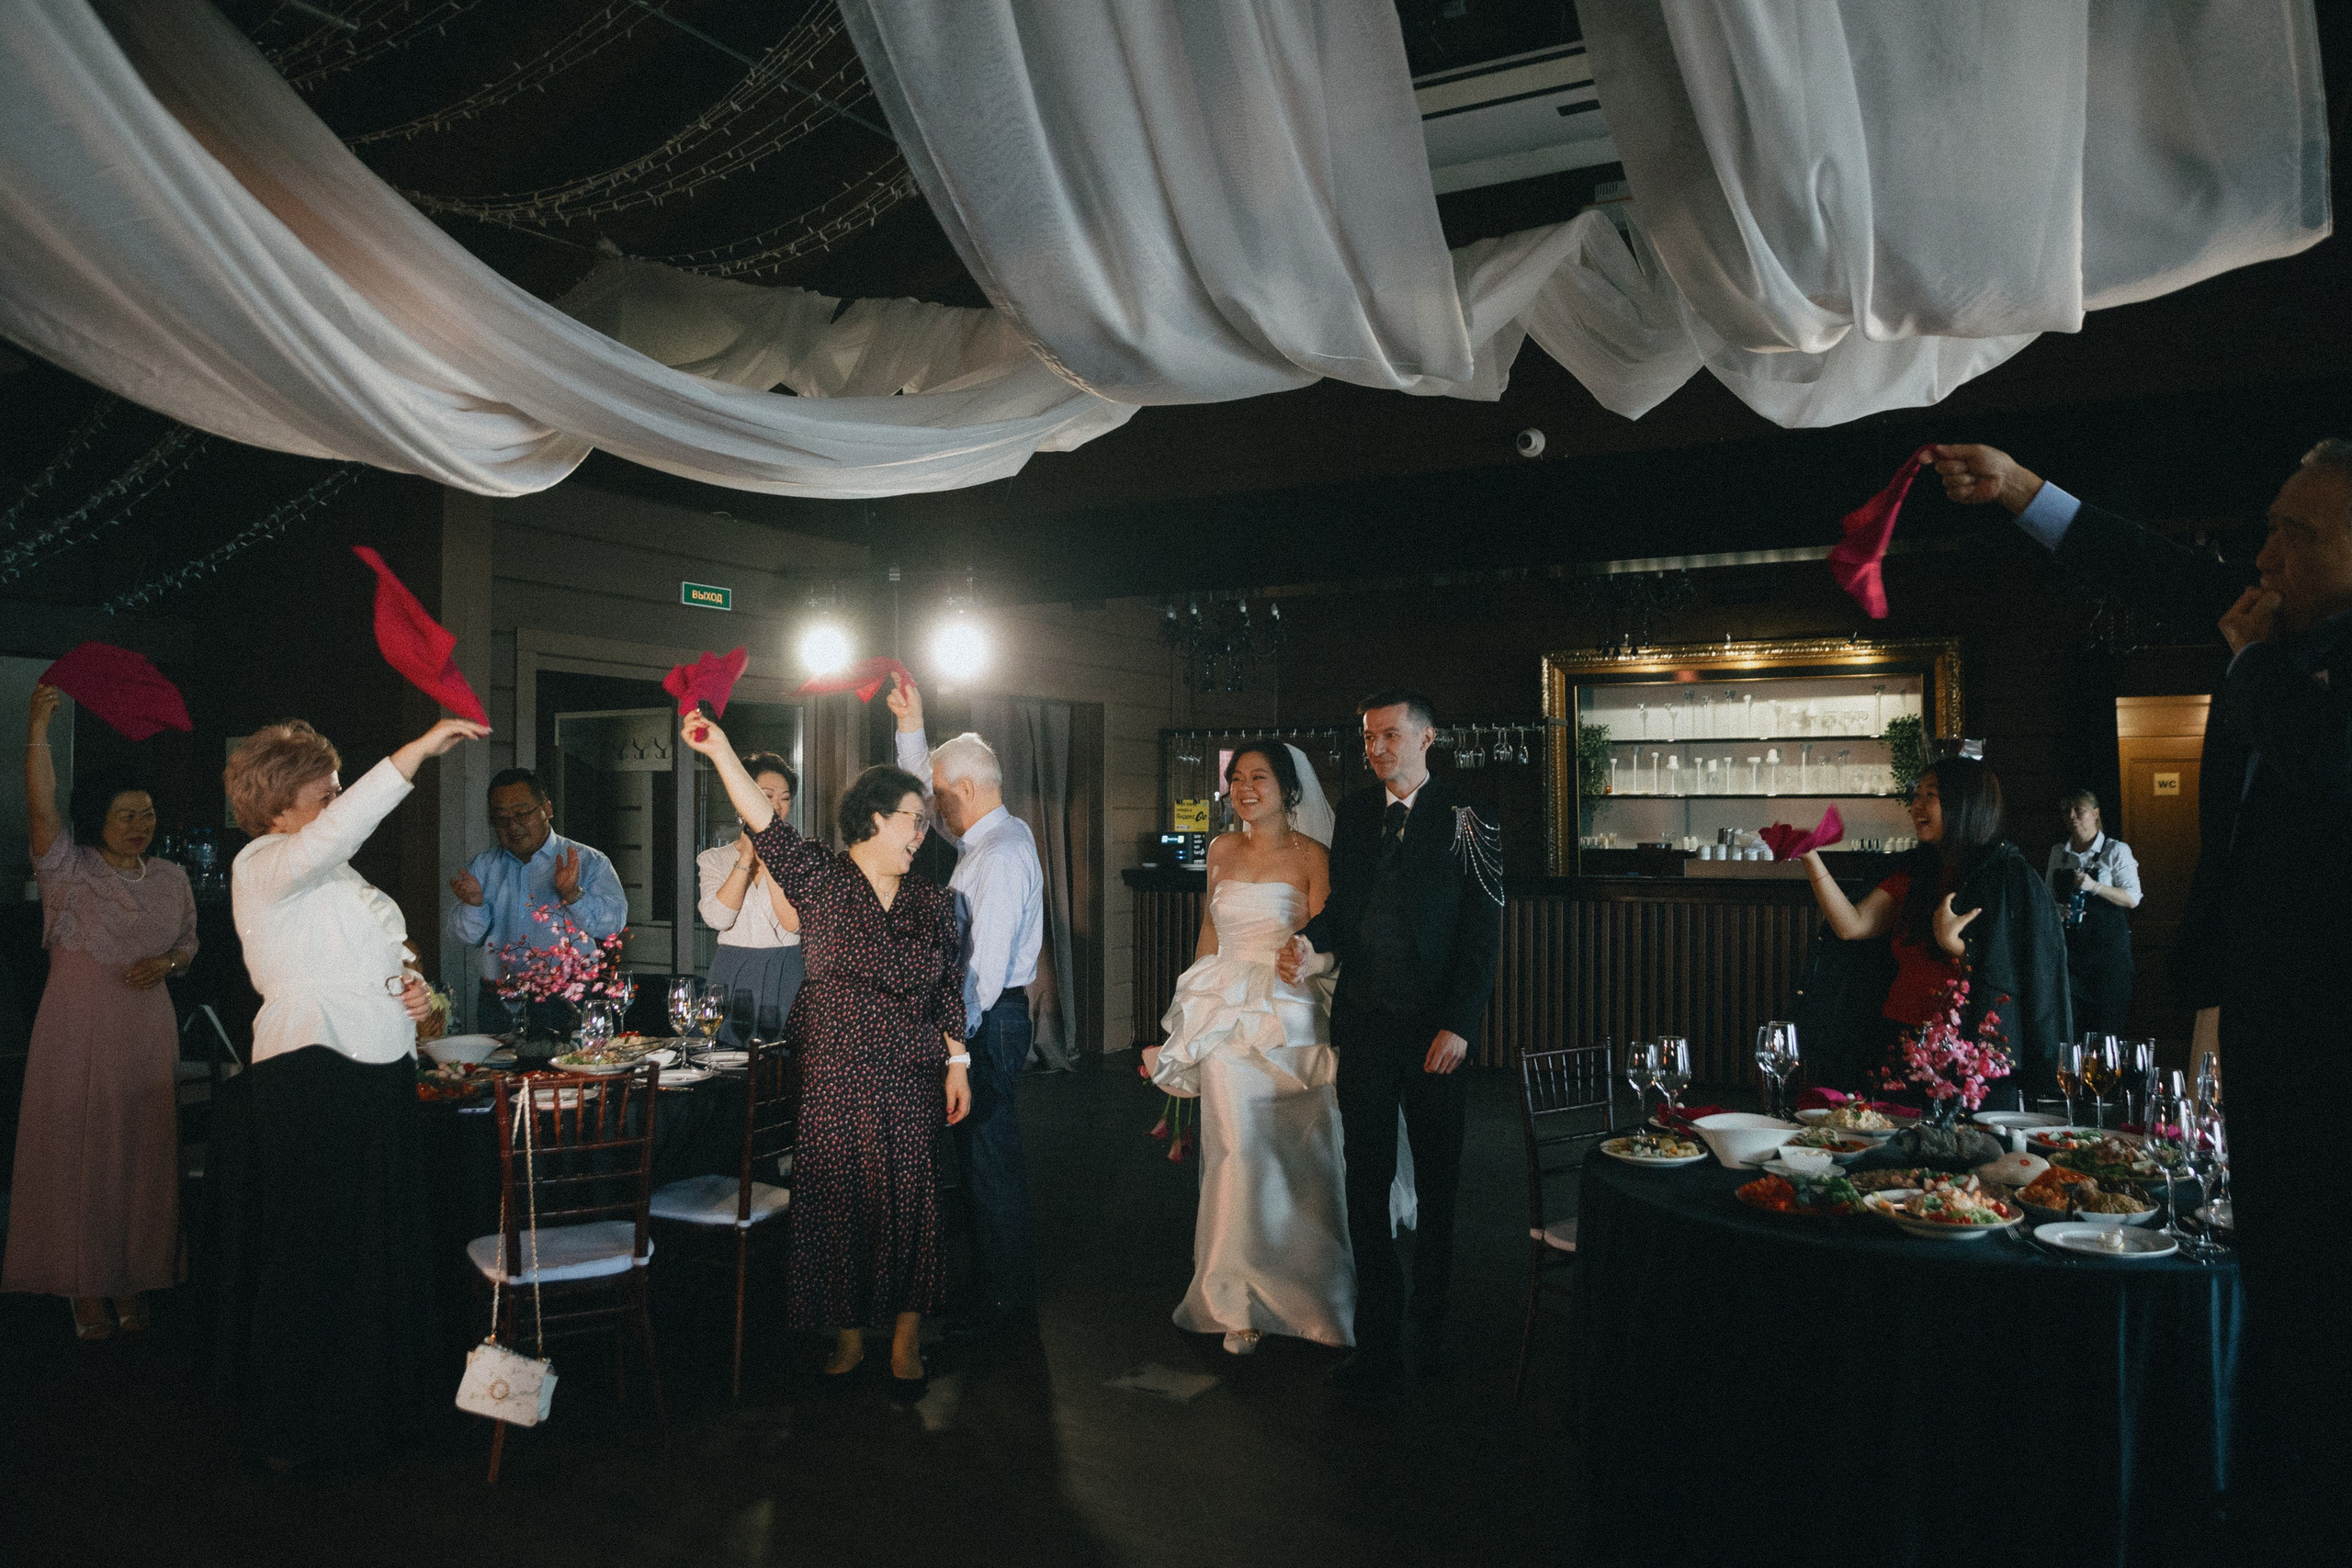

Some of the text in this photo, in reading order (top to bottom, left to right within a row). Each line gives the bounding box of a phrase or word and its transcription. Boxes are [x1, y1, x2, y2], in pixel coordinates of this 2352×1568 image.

[692, 590, 723, 604] ВЫХОД
[2158, 780, 2177, 788] WC
[1194, 810, 1207, 822] Go
